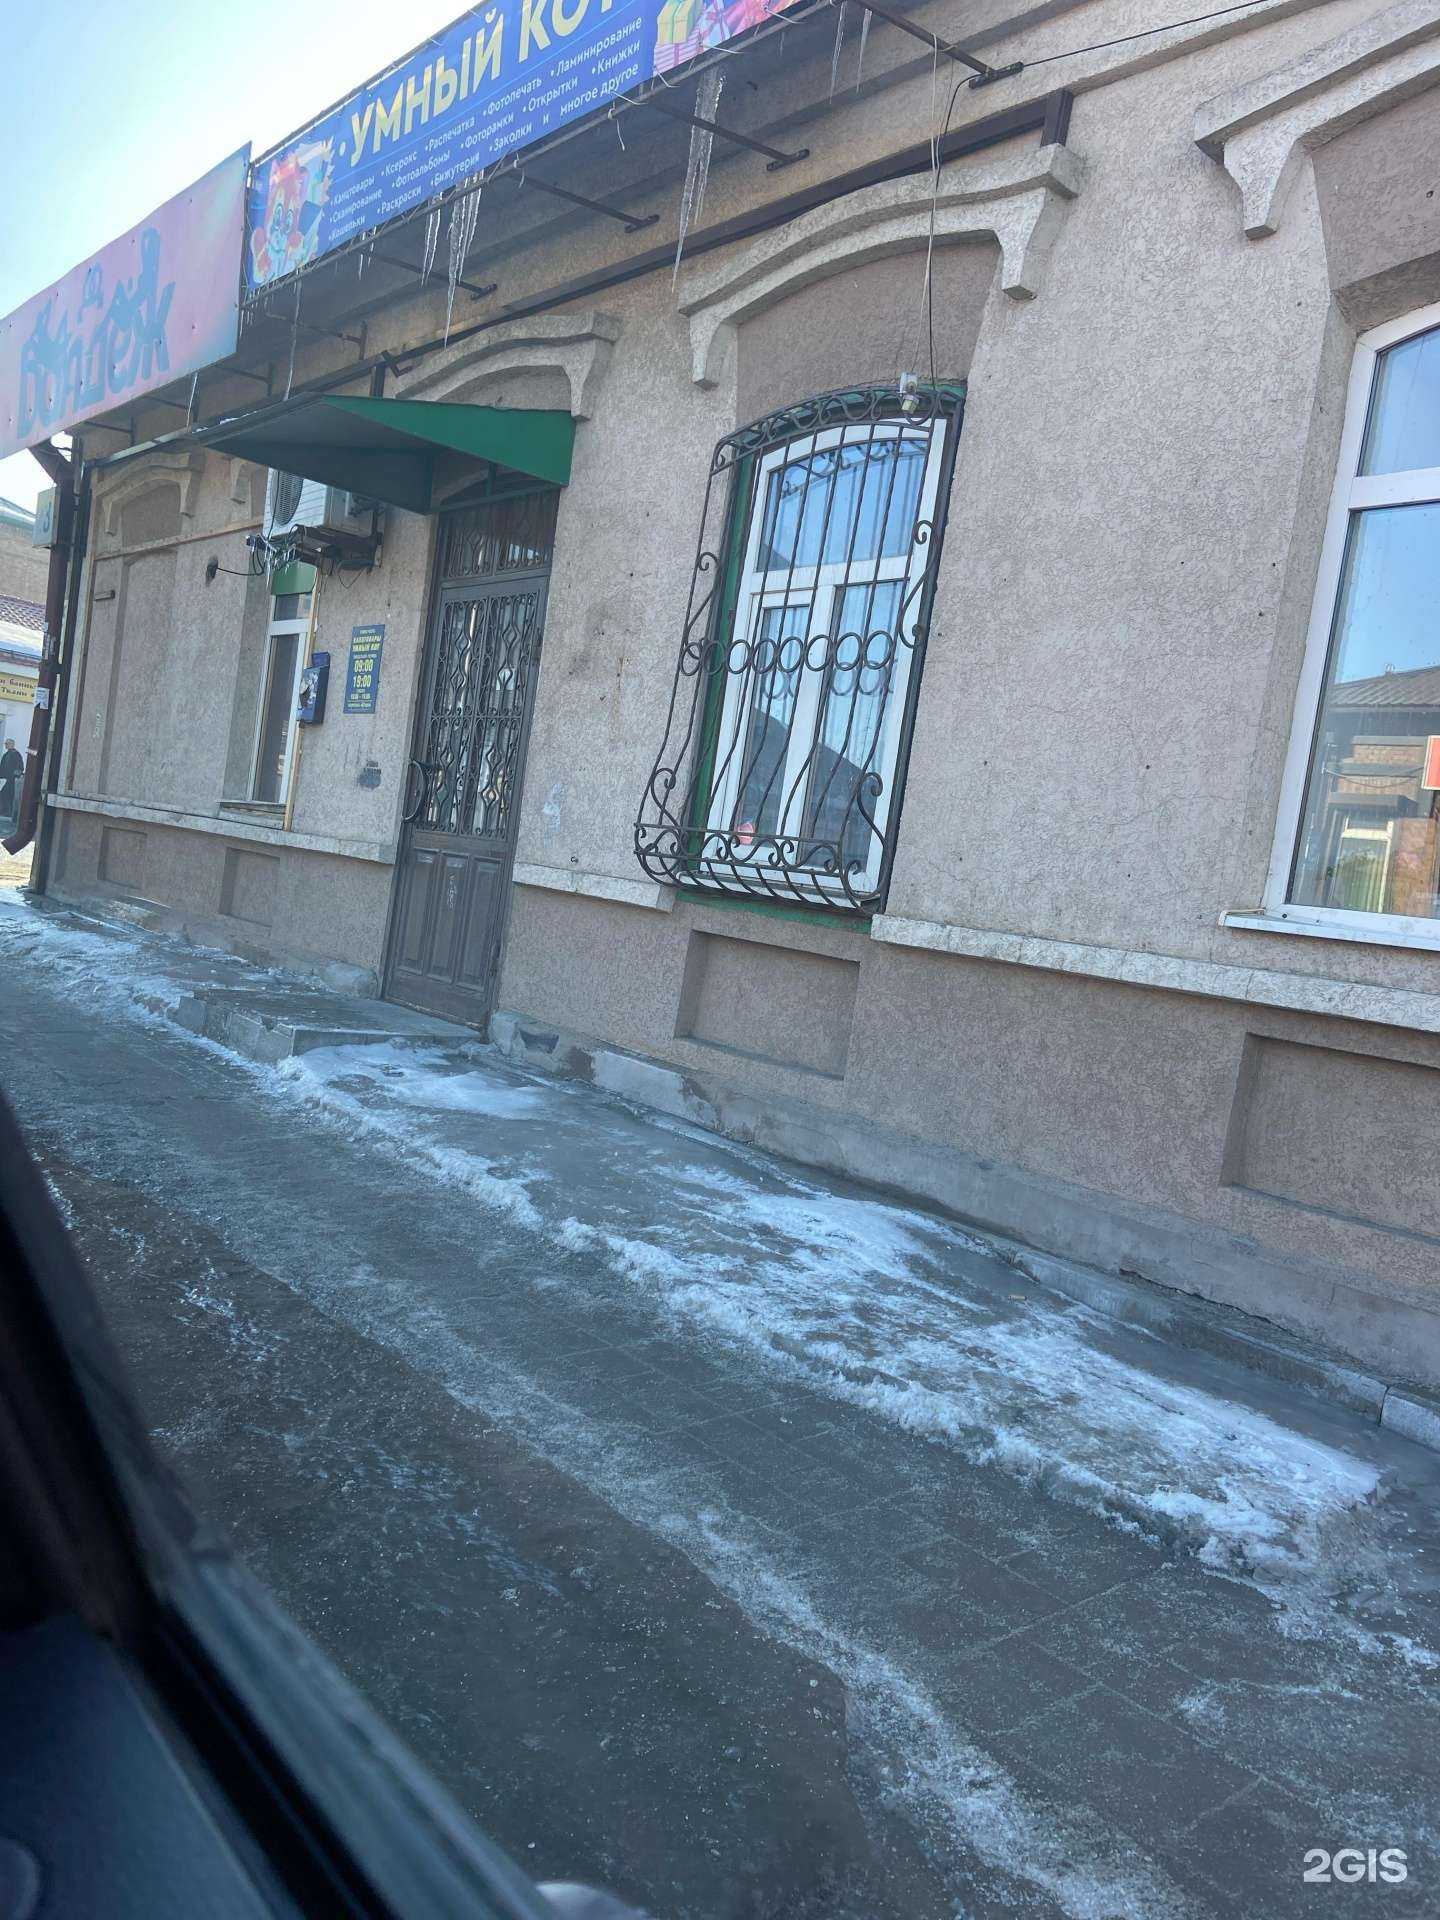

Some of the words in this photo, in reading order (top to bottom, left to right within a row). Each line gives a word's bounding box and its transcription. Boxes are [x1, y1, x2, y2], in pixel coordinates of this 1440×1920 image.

[350, 7, 503, 167] УМНЫЙ
[518, 0, 613, 63] КО
[381, 186, 422, 214] Раскраски
[493, 122, 532, 152] Заколки
[542, 113, 549, 125] и
[560, 87, 598, 117] многое
[600, 62, 639, 97] другое
[385, 150, 418, 176] Ксерокс
[429, 117, 475, 151] Распечатка
[487, 77, 542, 116] Фотопечать
[555, 16, 642, 77] Ламинирование
[395, 150, 450, 187] Фотоальбомы
[465, 112, 514, 149] Фоторамки
[528, 77, 578, 112] Открытки
[597, 41, 640, 76] Книжки
[354, 659, 374, 673] 09:00
